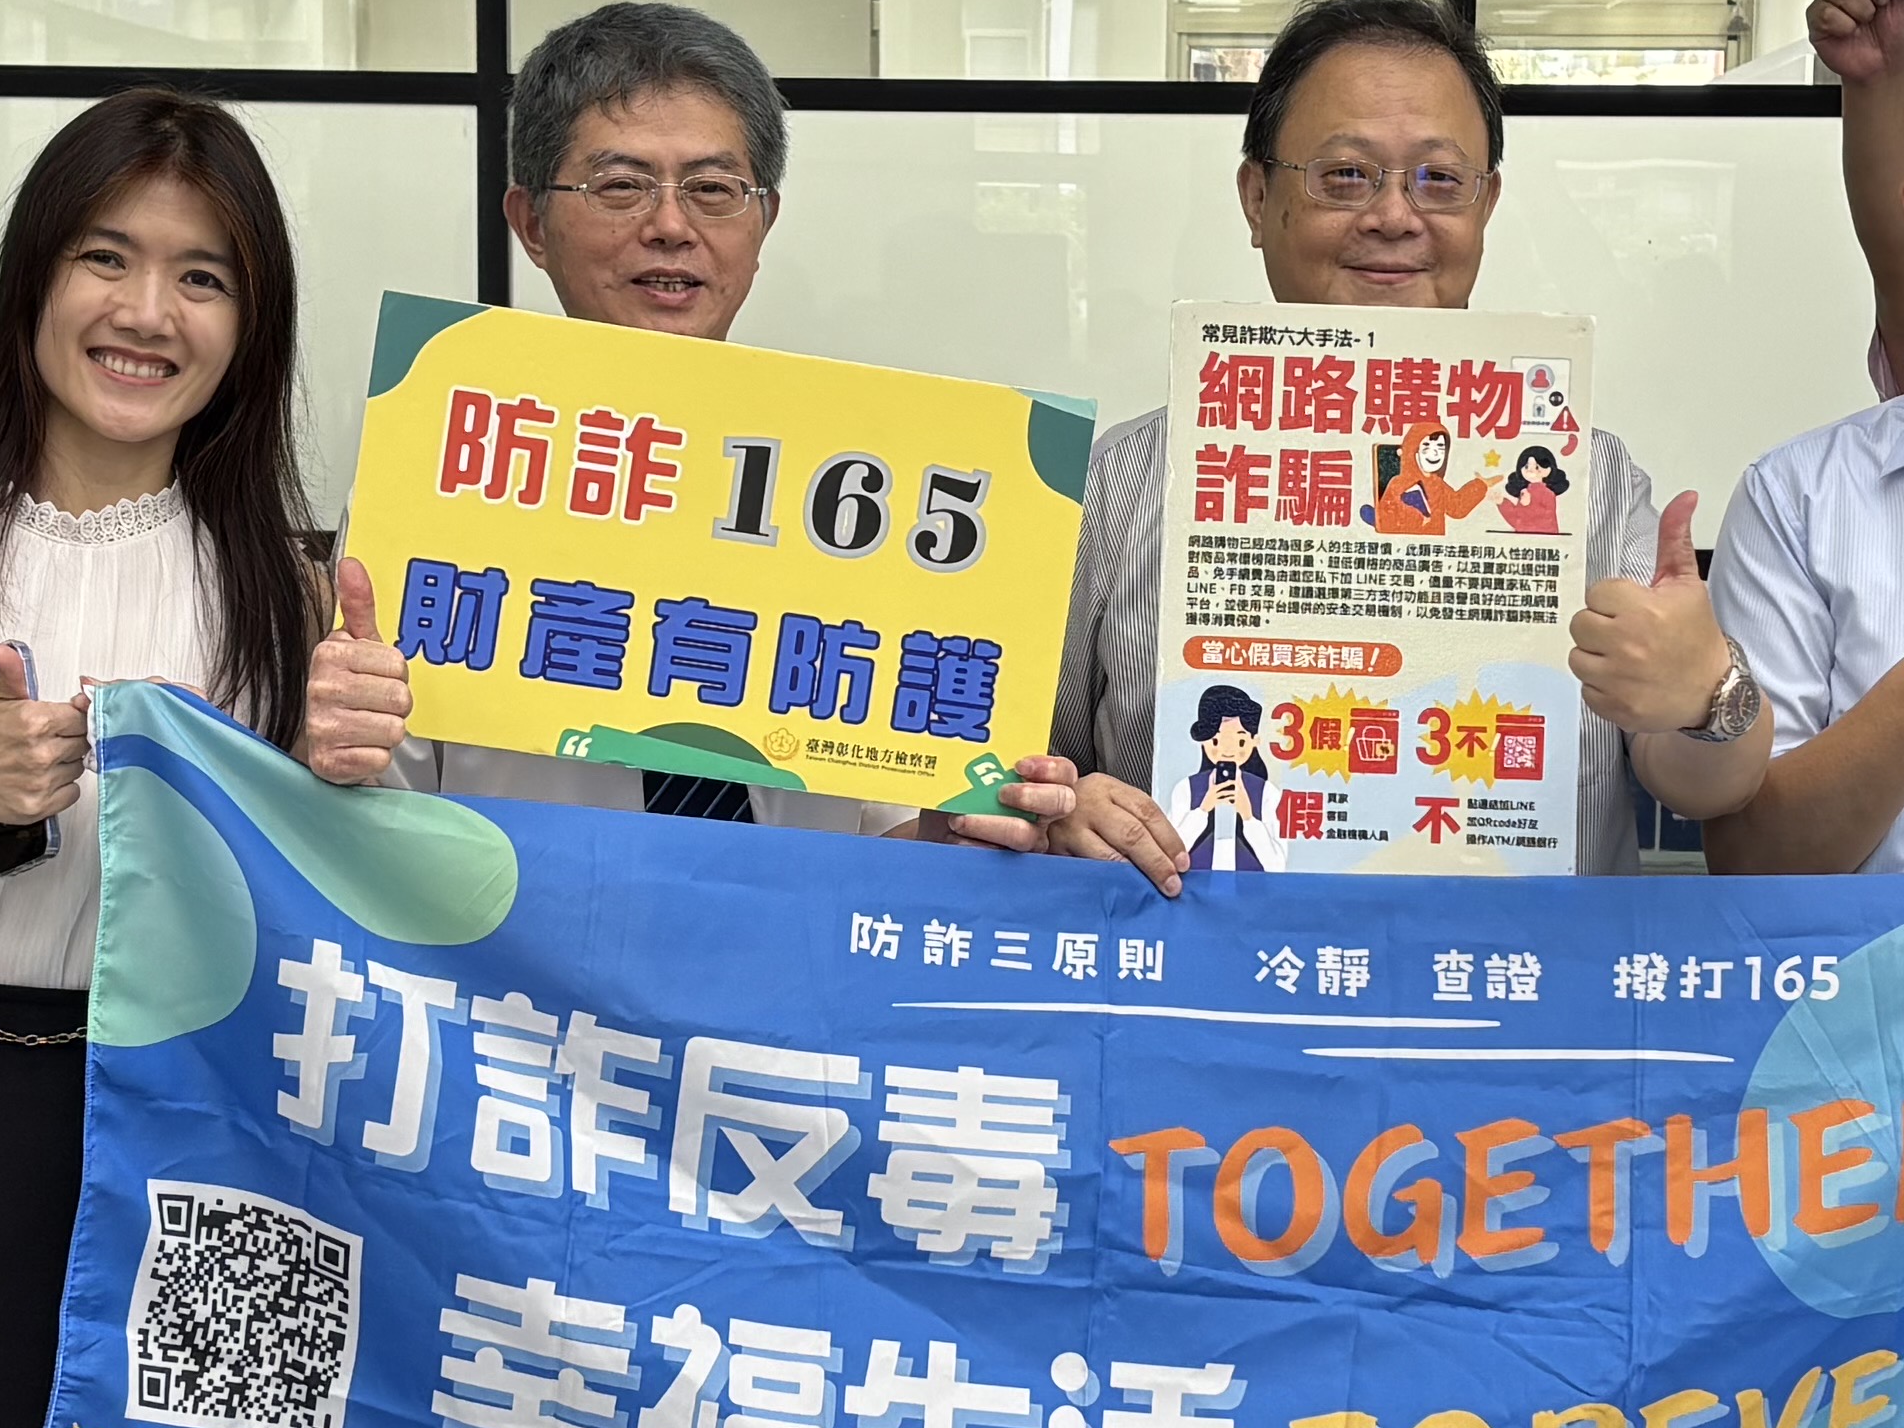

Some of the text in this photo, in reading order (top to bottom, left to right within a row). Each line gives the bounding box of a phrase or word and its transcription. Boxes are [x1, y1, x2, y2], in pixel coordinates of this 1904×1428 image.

[1196, 351, 1524, 440] 網路購物
[438, 386, 992, 573] 防詐 165
[1195, 443, 1353, 528] 詐騙
[1356, 573, 1386, 586] LINE
[396, 558, 1003, 743] 財產有防護
[805, 738, 938, 770] 臺灣彰化地方檢察署
[1276, 789, 1324, 840] 假
[1412, 797, 1461, 844] 不
[848, 911, 1842, 1003] 防詐三原則 冷靜 查證 撥打165
[270, 936, 1066, 1268] 打詐反毒
